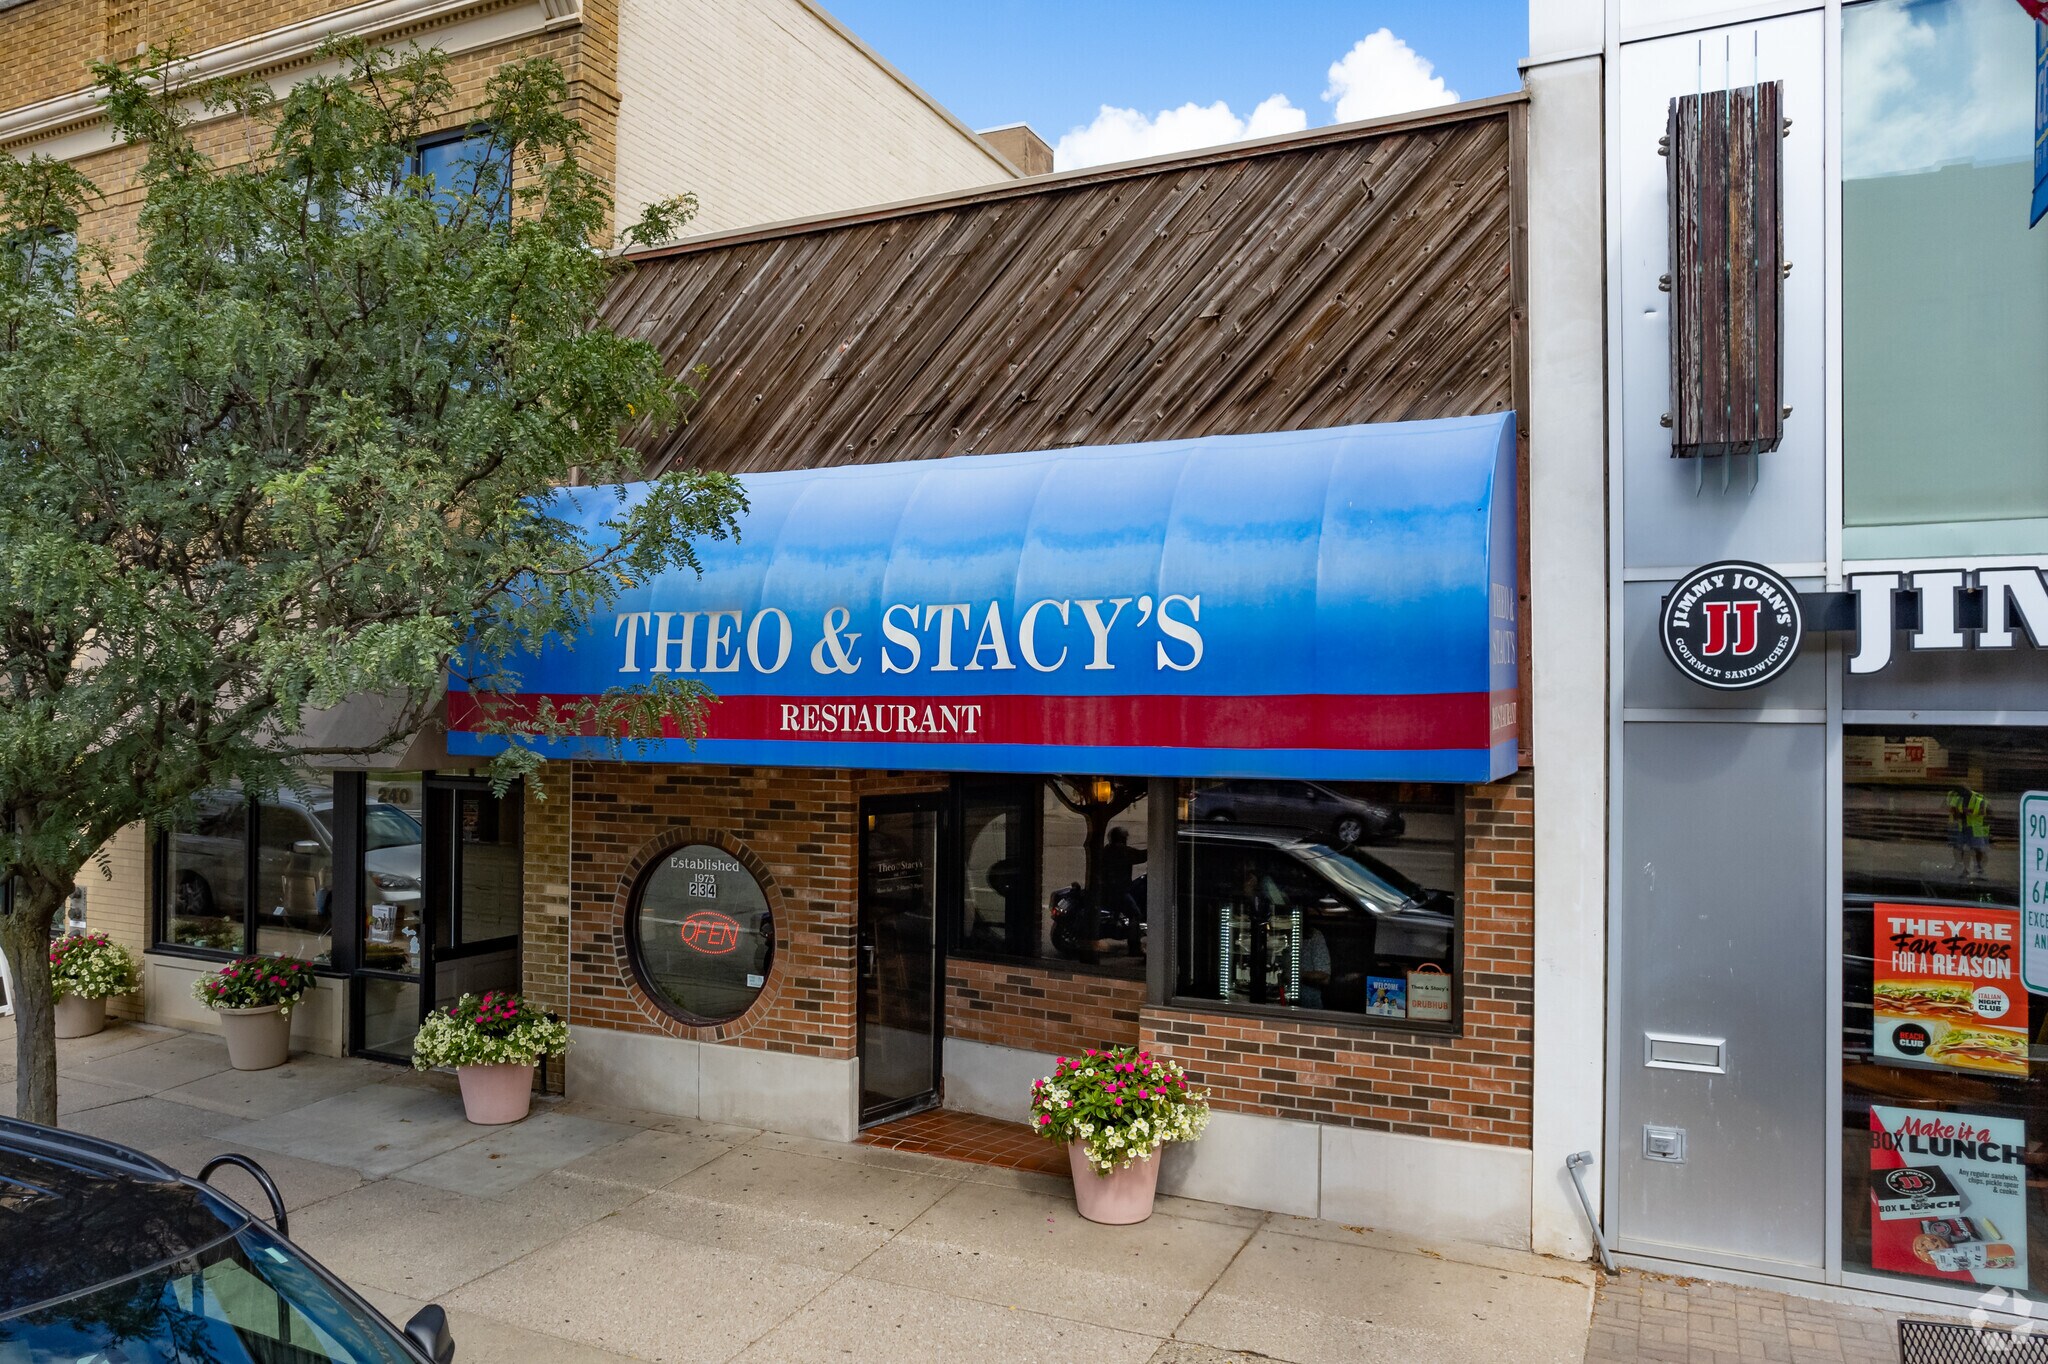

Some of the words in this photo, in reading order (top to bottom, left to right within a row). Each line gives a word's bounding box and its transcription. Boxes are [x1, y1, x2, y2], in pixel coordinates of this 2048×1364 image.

[1673, 574, 1724, 628] JIMMY
[1733, 573, 1791, 625] JOHN'S
[614, 607, 793, 674] THEO
[810, 607, 862, 675] &
[881, 594, 1205, 674] STACY'S
[1703, 600, 1761, 656] JJ
[1675, 637, 1721, 677] GOURMET
[1725, 635, 1789, 679] SANDWICHES
[780, 704, 982, 734] RESTAURANT
[378, 787, 410, 803] 240
[2030, 814, 2047, 839] 90
[671, 857, 740, 872] Established
[2036, 847, 2048, 872] P
[690, 883, 716, 898] 234
[694, 874, 715, 883] 1973
[1888, 918, 2012, 941] THEY'RE
[1890, 931, 1937, 956] Fan
[1942, 934, 2011, 959] Faves
[1892, 951, 1915, 973] FOR
[1919, 952, 1927, 974] A
[1933, 954, 2011, 979] REASON
[1373, 981, 1399, 991] WELCOME
[1900, 1039, 1924, 1047] CLUB
[1896, 1116, 1955, 1138] Make
[1958, 1122, 1974, 1140] it
[1976, 1128, 1991, 1143] a
[1871, 1130, 1904, 1151] BOX
[1909, 1135, 2026, 1165] LUNCH
[1959, 1168, 1969, 1177] Any
[1879, 1205, 1897, 1213] BOX
[1900, 1200, 1960, 1211] LUNCH
